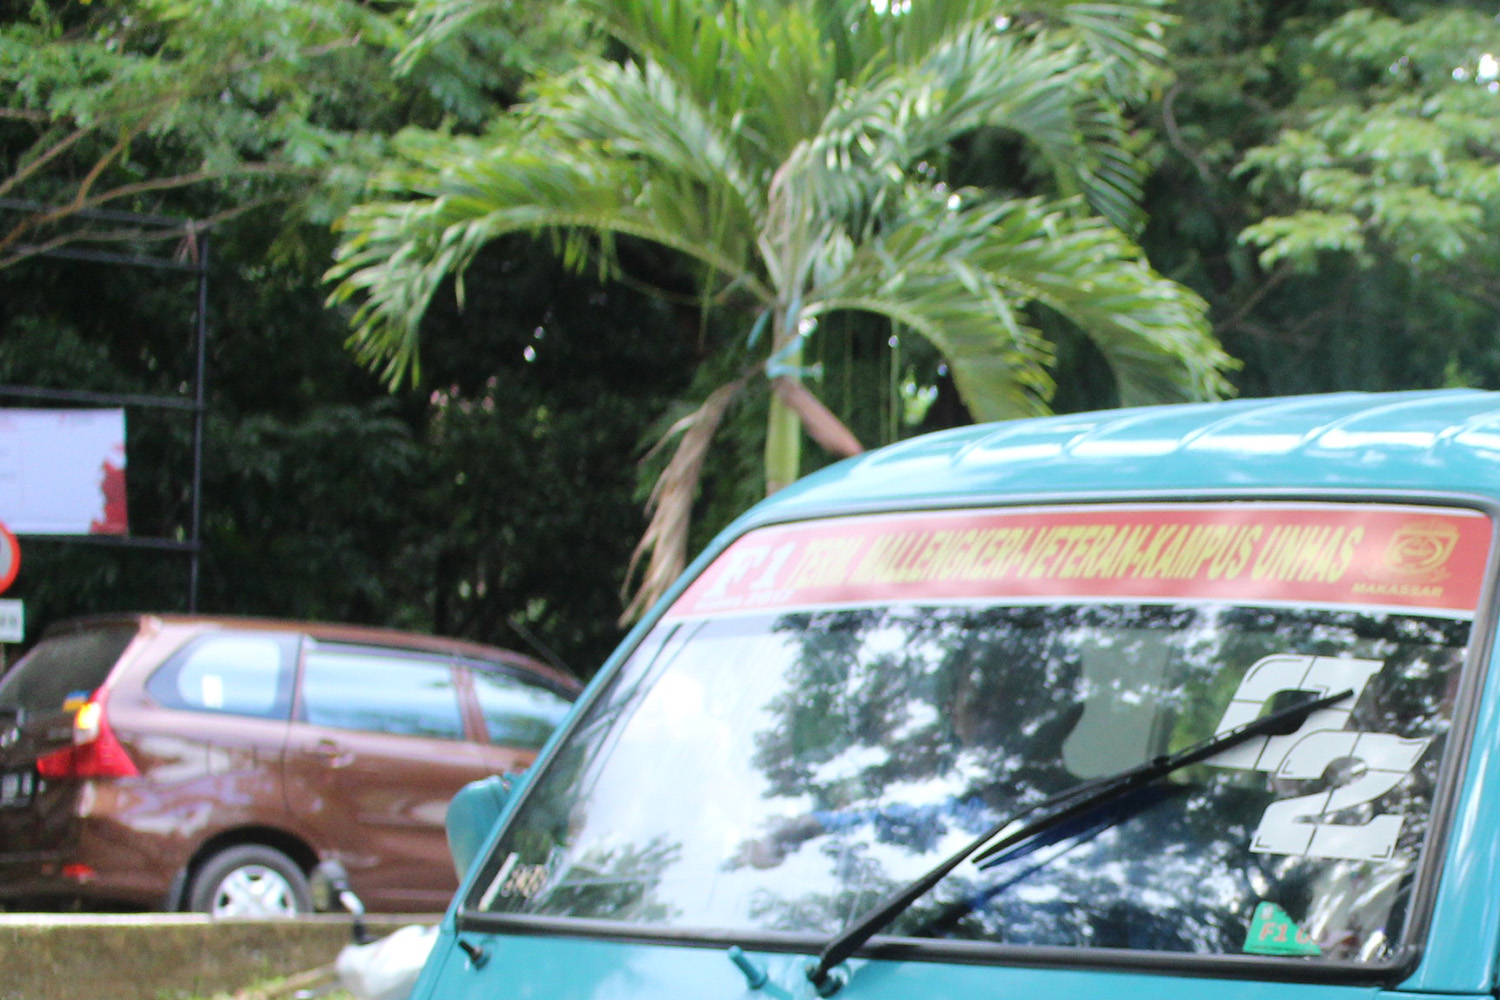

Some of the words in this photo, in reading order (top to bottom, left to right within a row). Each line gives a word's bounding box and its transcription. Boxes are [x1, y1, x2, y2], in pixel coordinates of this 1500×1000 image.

[703, 542, 796, 597] F1
[1251, 524, 1364, 583] UNHAS
[1352, 583, 1443, 597] MAKASSAR
